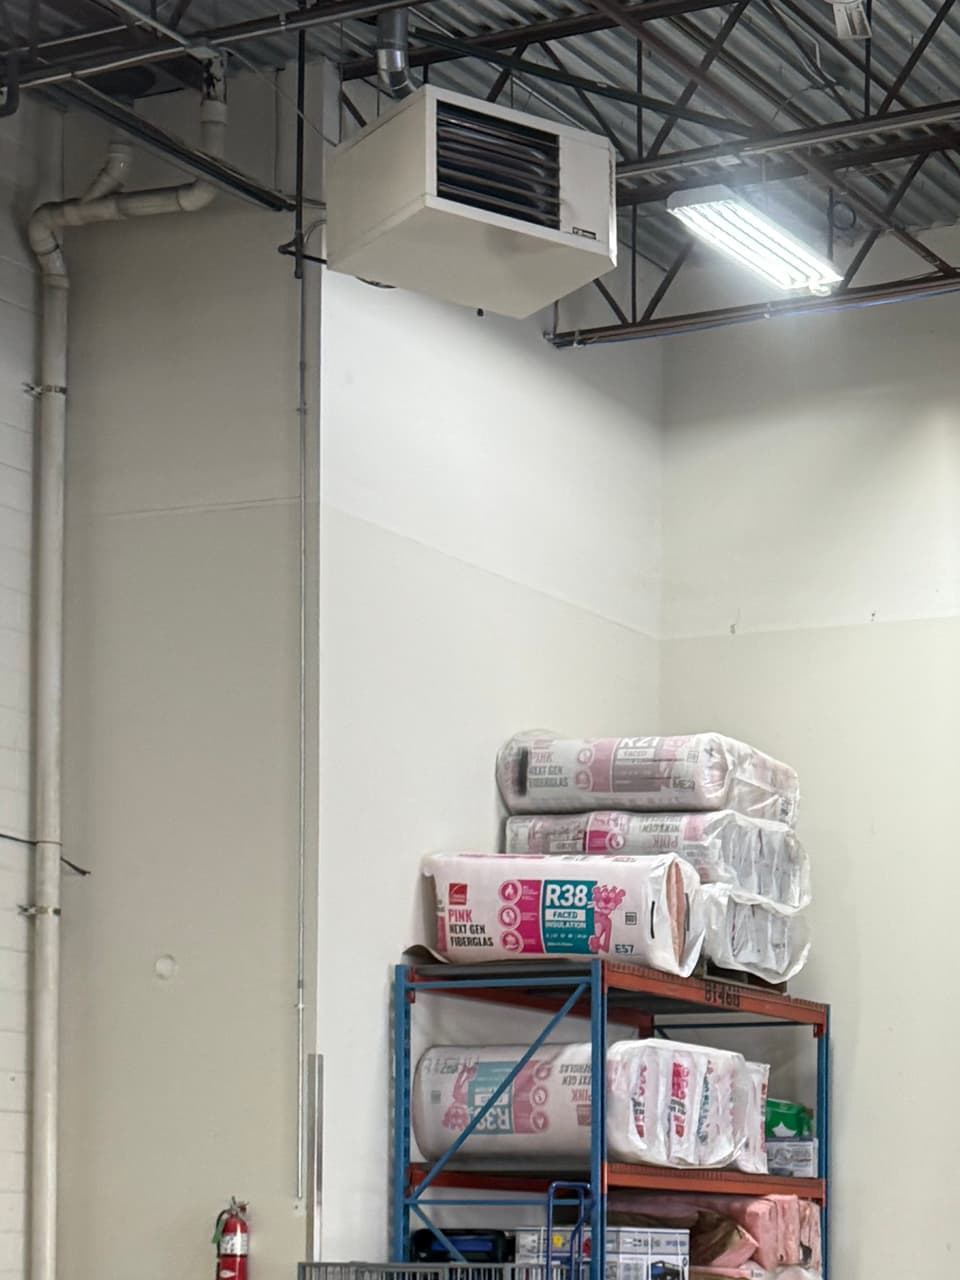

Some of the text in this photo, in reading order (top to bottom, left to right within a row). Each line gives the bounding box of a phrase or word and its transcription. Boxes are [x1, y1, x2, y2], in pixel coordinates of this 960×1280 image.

[545, 884, 588, 907] R38
[448, 909, 472, 923] PINK
[552, 911, 578, 919] FACED
[449, 923, 486, 934] NEXT GEN
[545, 920, 587, 929] INSULATION
[450, 936, 494, 947] FIBERGLAS
